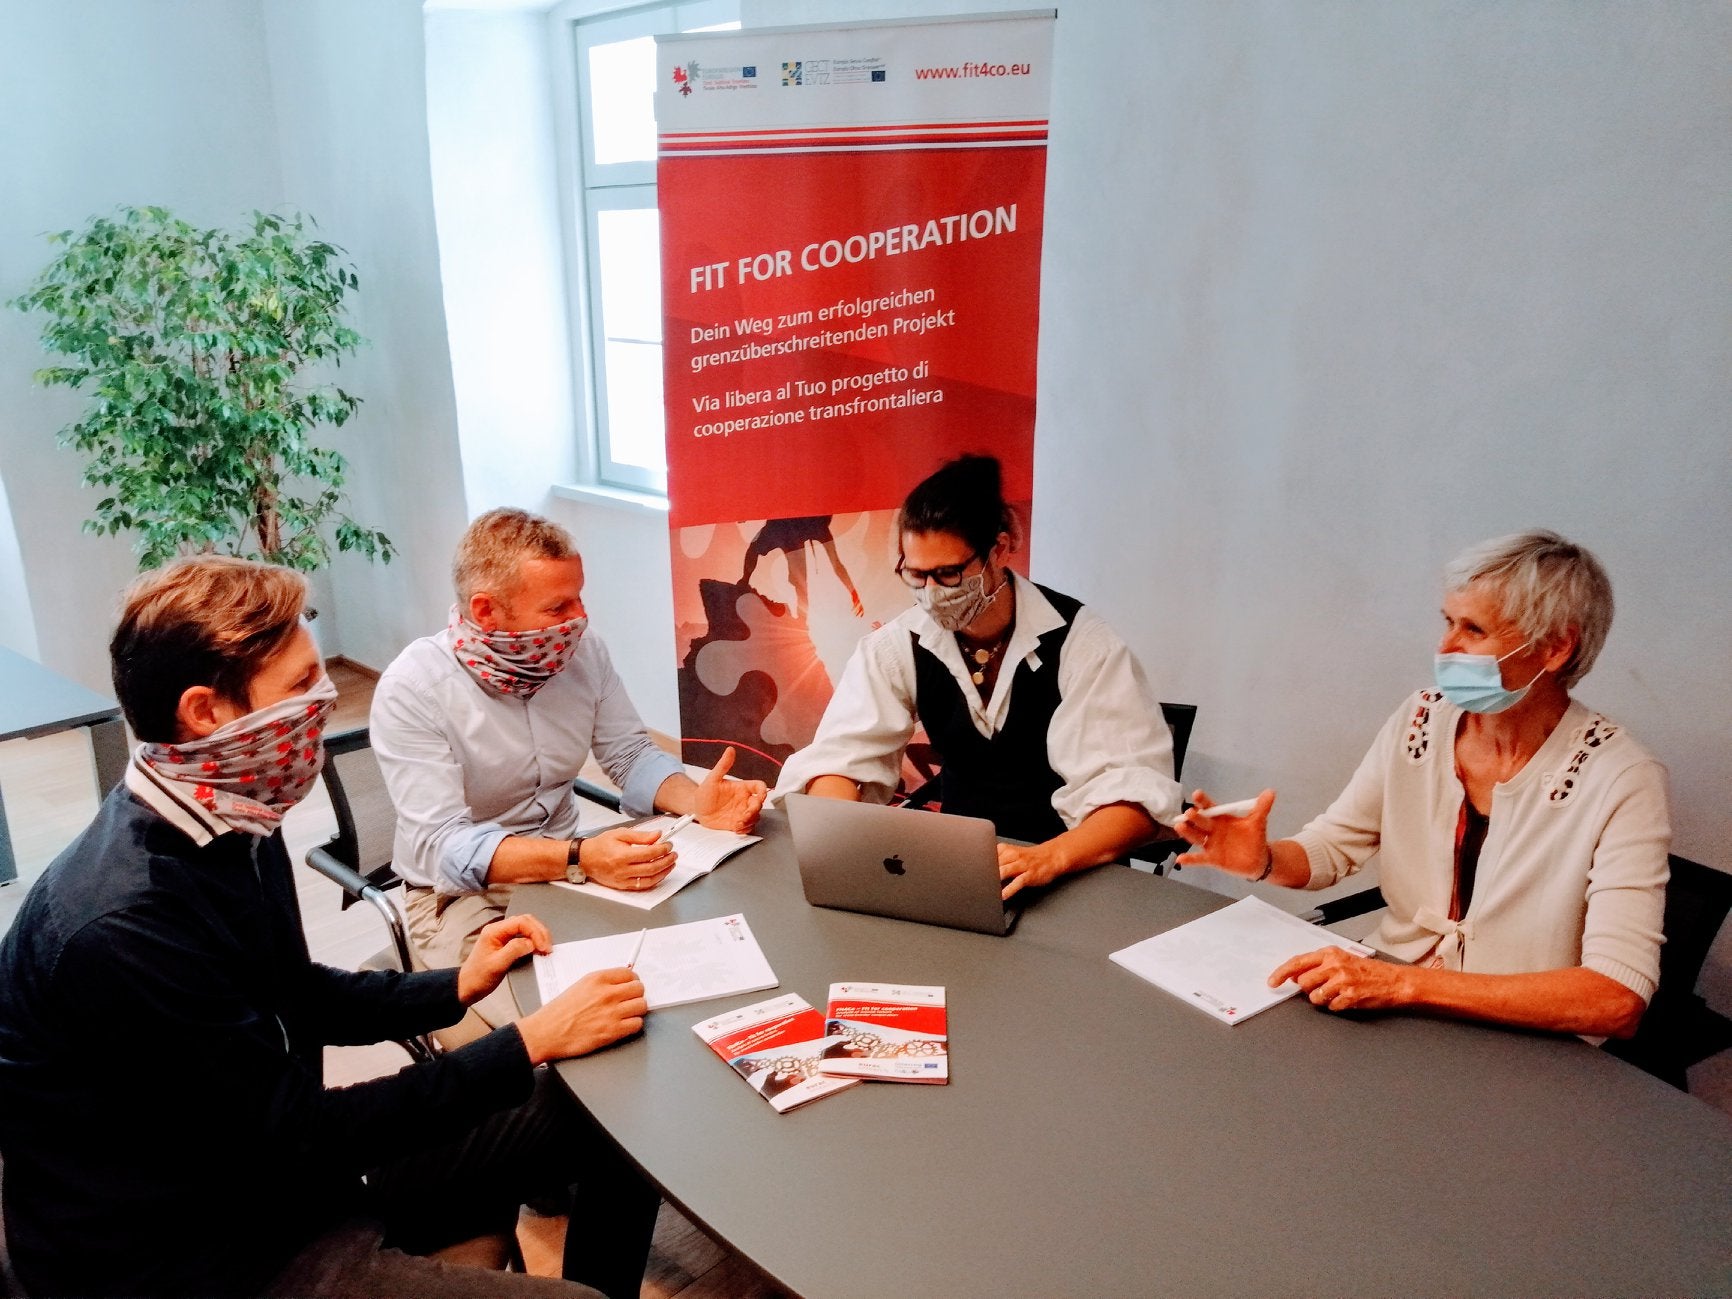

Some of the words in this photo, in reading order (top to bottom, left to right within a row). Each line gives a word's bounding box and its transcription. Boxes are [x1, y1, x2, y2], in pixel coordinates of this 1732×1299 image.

[915, 62, 1031, 79] www.fit4co.eu
[690, 261, 730, 294] FIT
[738, 250, 793, 285] FOR
[801, 203, 1017, 271] COOPERATION
[690, 323, 731, 344] Dein
[734, 317, 773, 336] Weg
[777, 310, 813, 329] zum
[818, 288, 935, 321] erfolgreichen
[691, 323, 888, 373] grenzüberschreitenden
[893, 309, 956, 335] Projekt
[692, 395, 720, 413] Via
[725, 388, 772, 408] libera
[776, 382, 791, 400] al
[795, 380, 826, 397] Tuo
[831, 366, 908, 396] progetto
[912, 360, 929, 379] di
[693, 410, 805, 438] cooperazione
[809, 389, 944, 421] transfrontaliera
